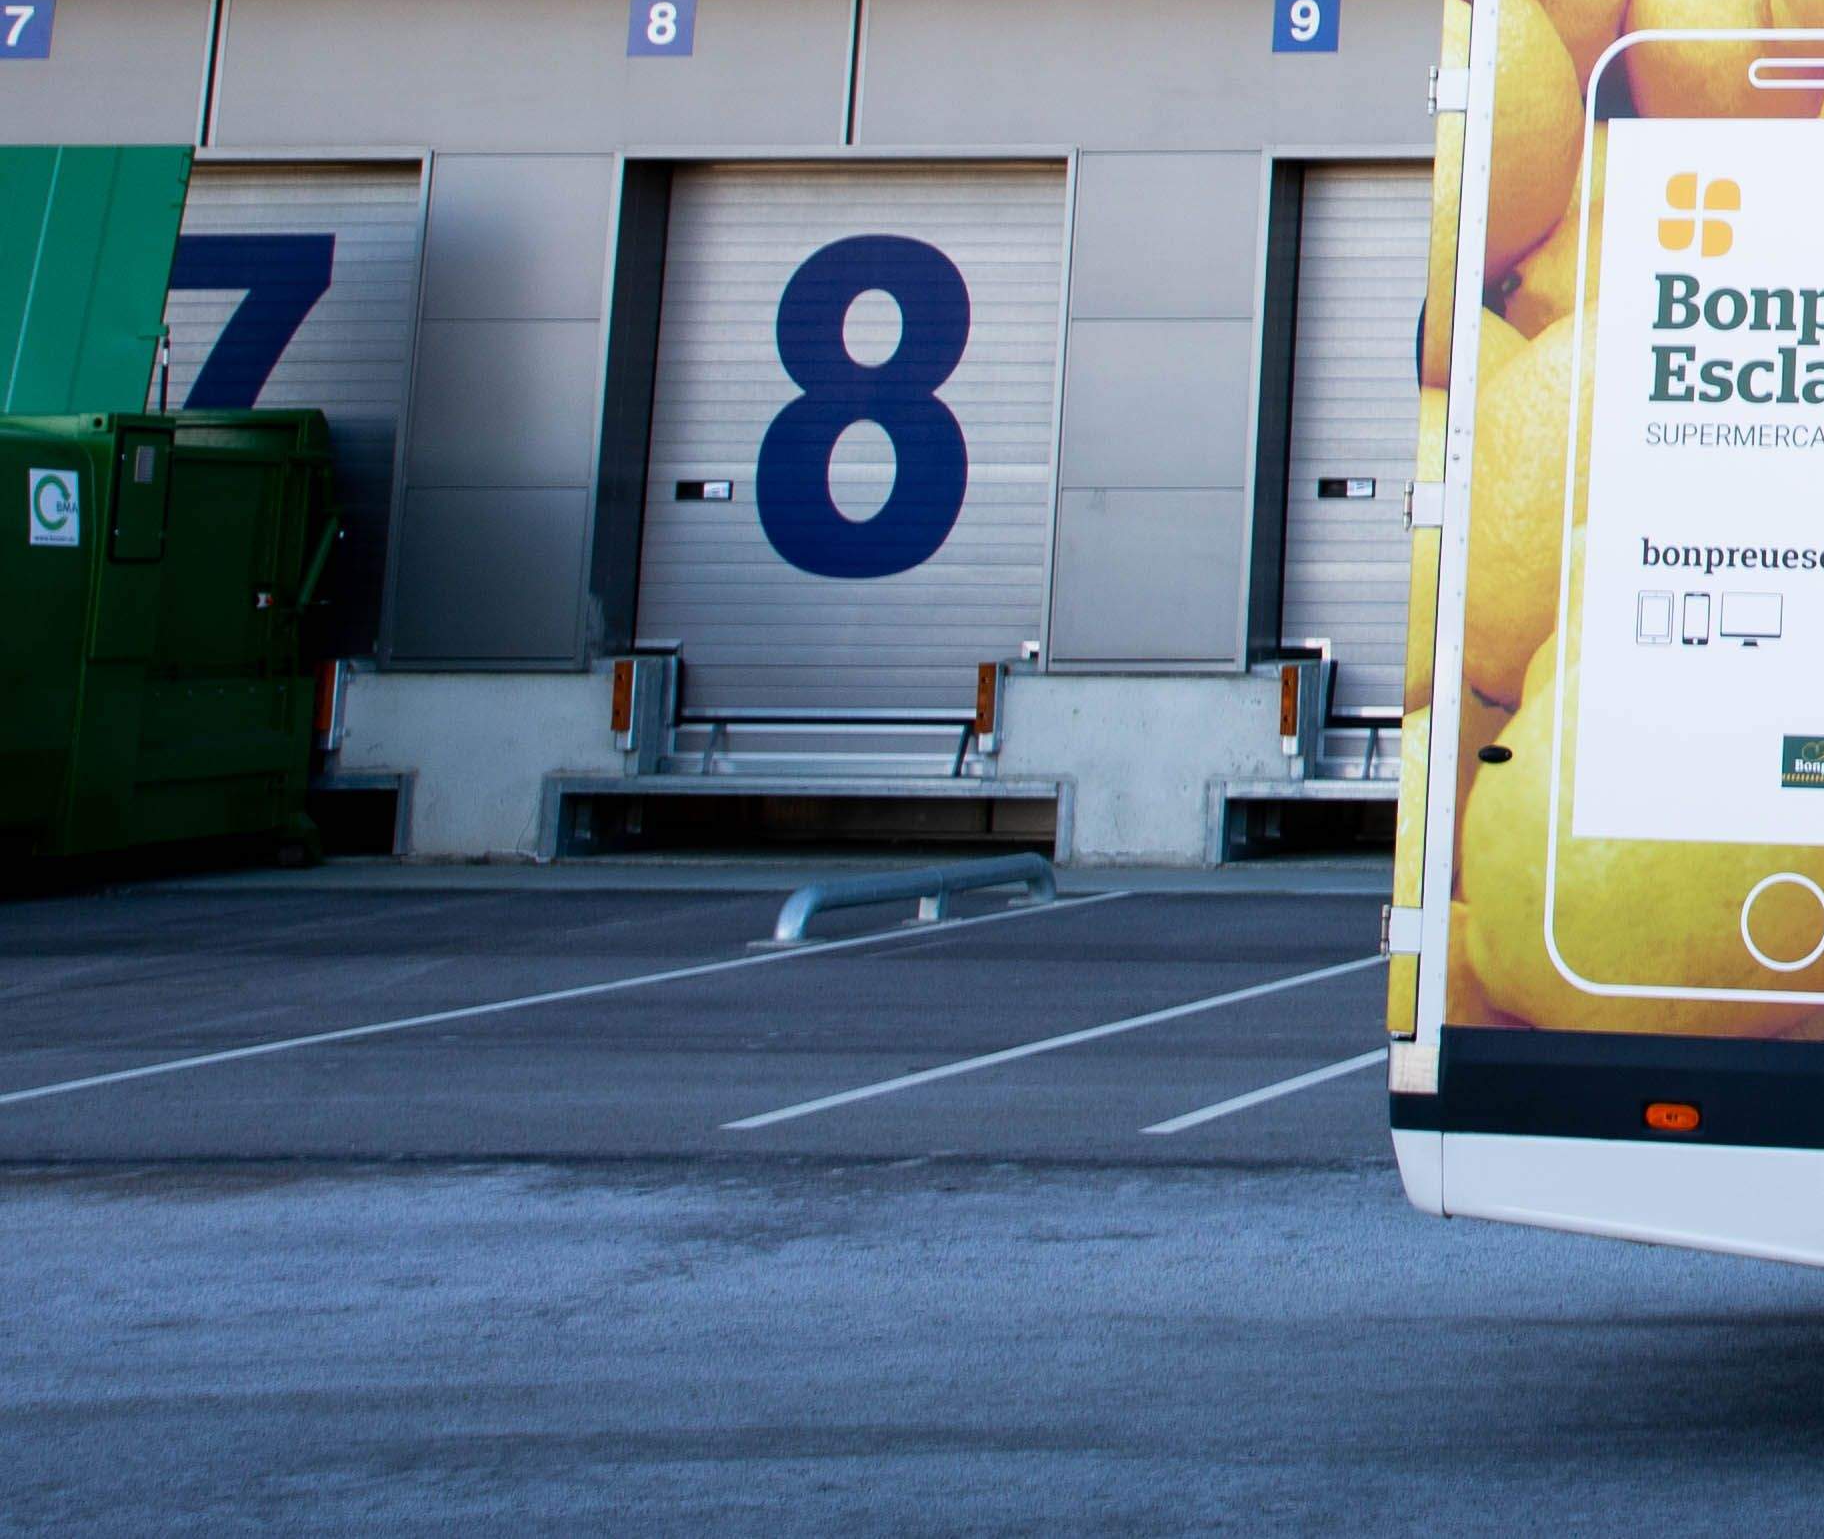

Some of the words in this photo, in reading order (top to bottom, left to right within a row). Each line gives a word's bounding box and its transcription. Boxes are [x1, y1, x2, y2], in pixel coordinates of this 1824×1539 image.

[5, 5, 35, 47] 7
[647, 0, 677, 45] 8
[756, 235, 969, 579] 8
